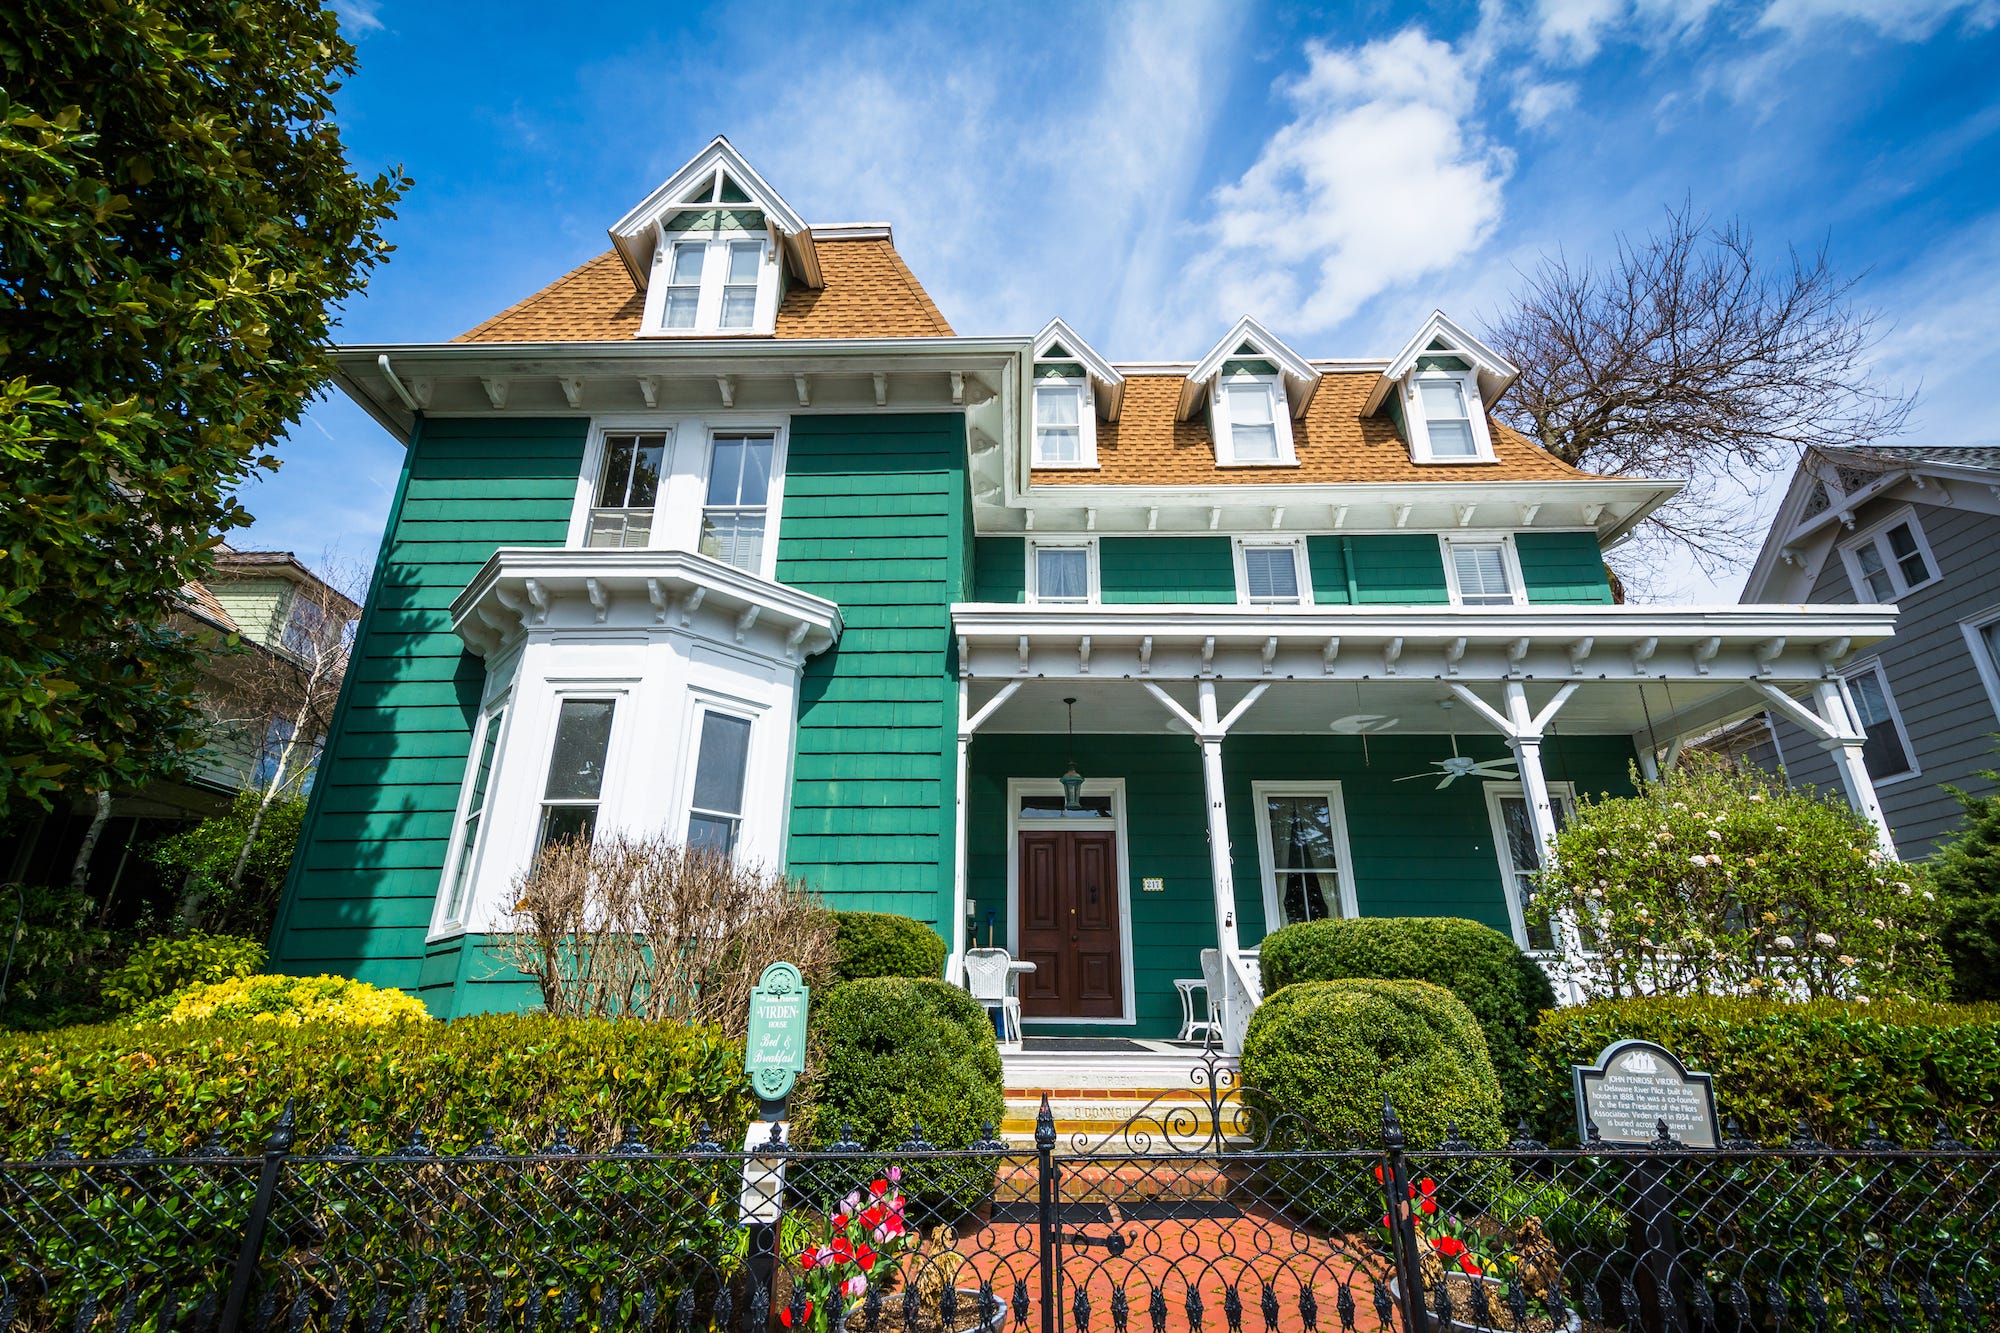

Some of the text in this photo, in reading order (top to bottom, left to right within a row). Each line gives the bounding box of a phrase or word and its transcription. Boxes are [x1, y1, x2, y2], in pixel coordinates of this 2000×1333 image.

[1146, 880, 1160, 889] 217
[759, 1005, 797, 1019] VIRDEN
[768, 1020, 788, 1028] HOUSE
[760, 1032, 791, 1050] Bed &
[753, 1049, 796, 1066] Breakfast
[1608, 1075, 1626, 1083] JOHN
[1626, 1076, 1654, 1085] PENROSE
[1604, 1084, 1633, 1093] Delaware
[1633, 1085, 1649, 1094] River
[1667, 1087, 1680, 1095] built
[1682, 1088, 1693, 1096] this
[1592, 1091, 1611, 1100] house
[1667, 1095, 1700, 1105] co-founder
[1598, 1100, 1605, 1108] &
[1606, 1101, 1617, 1109] the
[1618, 1101, 1631, 1109] first
[1631, 1102, 1660, 1111] President
[1661, 1103, 1668, 1111] of
[1669, 1104, 1680, 1112] the
[1631, 1111, 1652, 1119] Virden
[1653, 1112, 1667, 1120] died
[1675, 1113, 1690, 1121] 1934
[1691, 1114, 1703, 1122] and
[1613, 1119, 1634, 1128] buried
[1635, 1121, 1656, 1129] across
[1668, 1122, 1687, 1130] street
